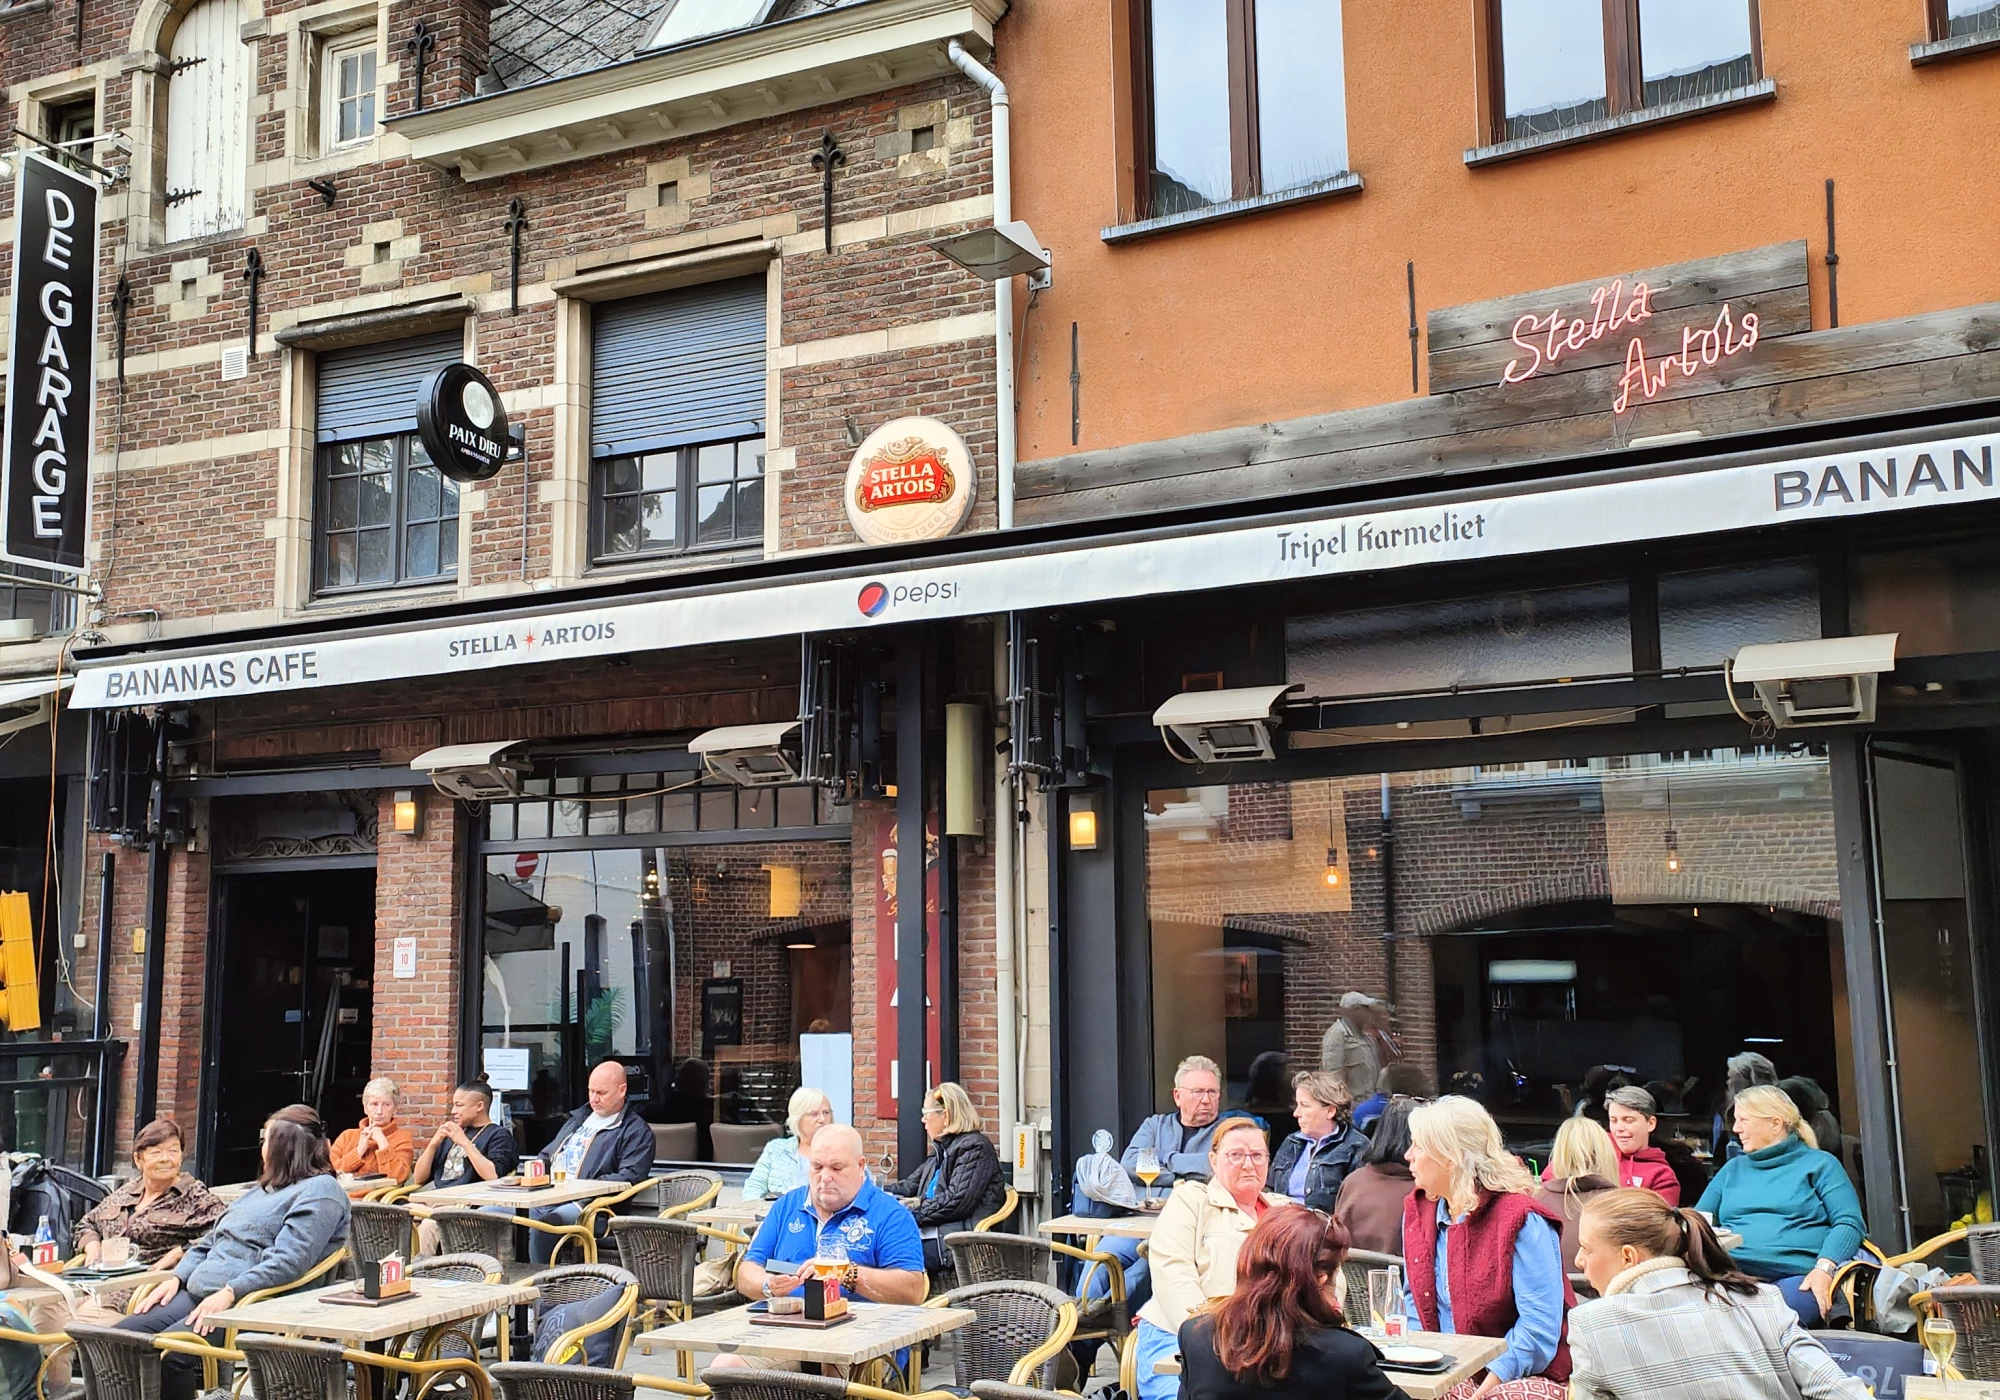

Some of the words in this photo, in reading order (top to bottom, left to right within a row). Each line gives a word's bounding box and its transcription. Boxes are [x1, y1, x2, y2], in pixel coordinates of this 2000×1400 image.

[43, 189, 75, 270] DE
[1498, 279, 1662, 388] Stella
[1612, 302, 1759, 414] Artois
[31, 281, 74, 539] GARAGE
[448, 423, 478, 449] PAIX
[478, 435, 502, 460] DIEU
[460, 446, 491, 466] AMBASSADEUR
[870, 462, 935, 485] STELLA
[870, 477, 937, 500] ARTOIS
[1774, 445, 1994, 512] BANAN
[869, 522, 899, 541] ANNO
[914, 514, 942, 536] 1366
[1277, 522, 1347, 568] Tripel
[1357, 509, 1486, 553] Karmeliet
[892, 582, 959, 608] pepsi
[449, 634, 518, 658] STELLA
[540, 622, 616, 647] ARTOIS
[105, 660, 237, 699] BANANAS
[246, 651, 319, 685] CAFE
[401, 953, 409, 965] 10
